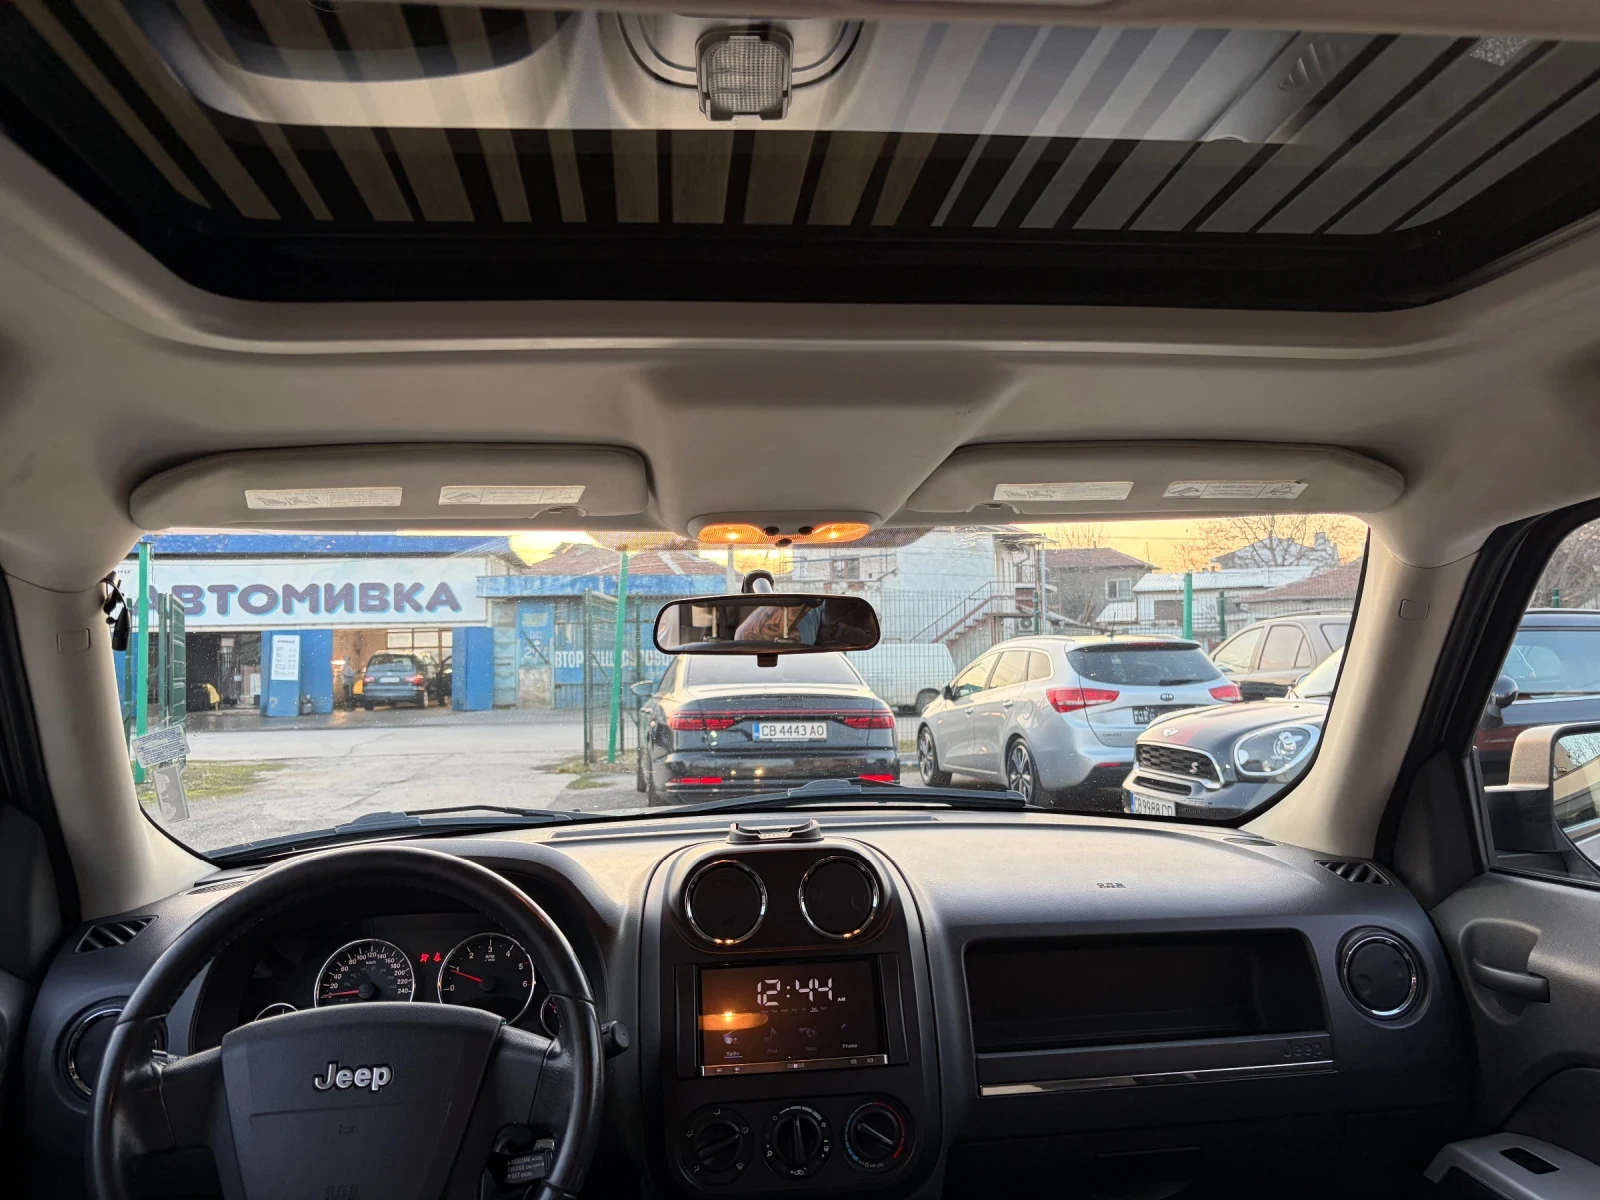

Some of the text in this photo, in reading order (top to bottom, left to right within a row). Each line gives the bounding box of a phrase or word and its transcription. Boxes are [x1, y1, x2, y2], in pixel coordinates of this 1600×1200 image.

[132, 582, 463, 617] АВТОМИВКА
[761, 725, 824, 737] CB 4443 AO
[757, 977, 833, 1007] 12:44
[314, 1062, 392, 1091] Jeep
[507, 1164, 525, 1172] CRUISE
